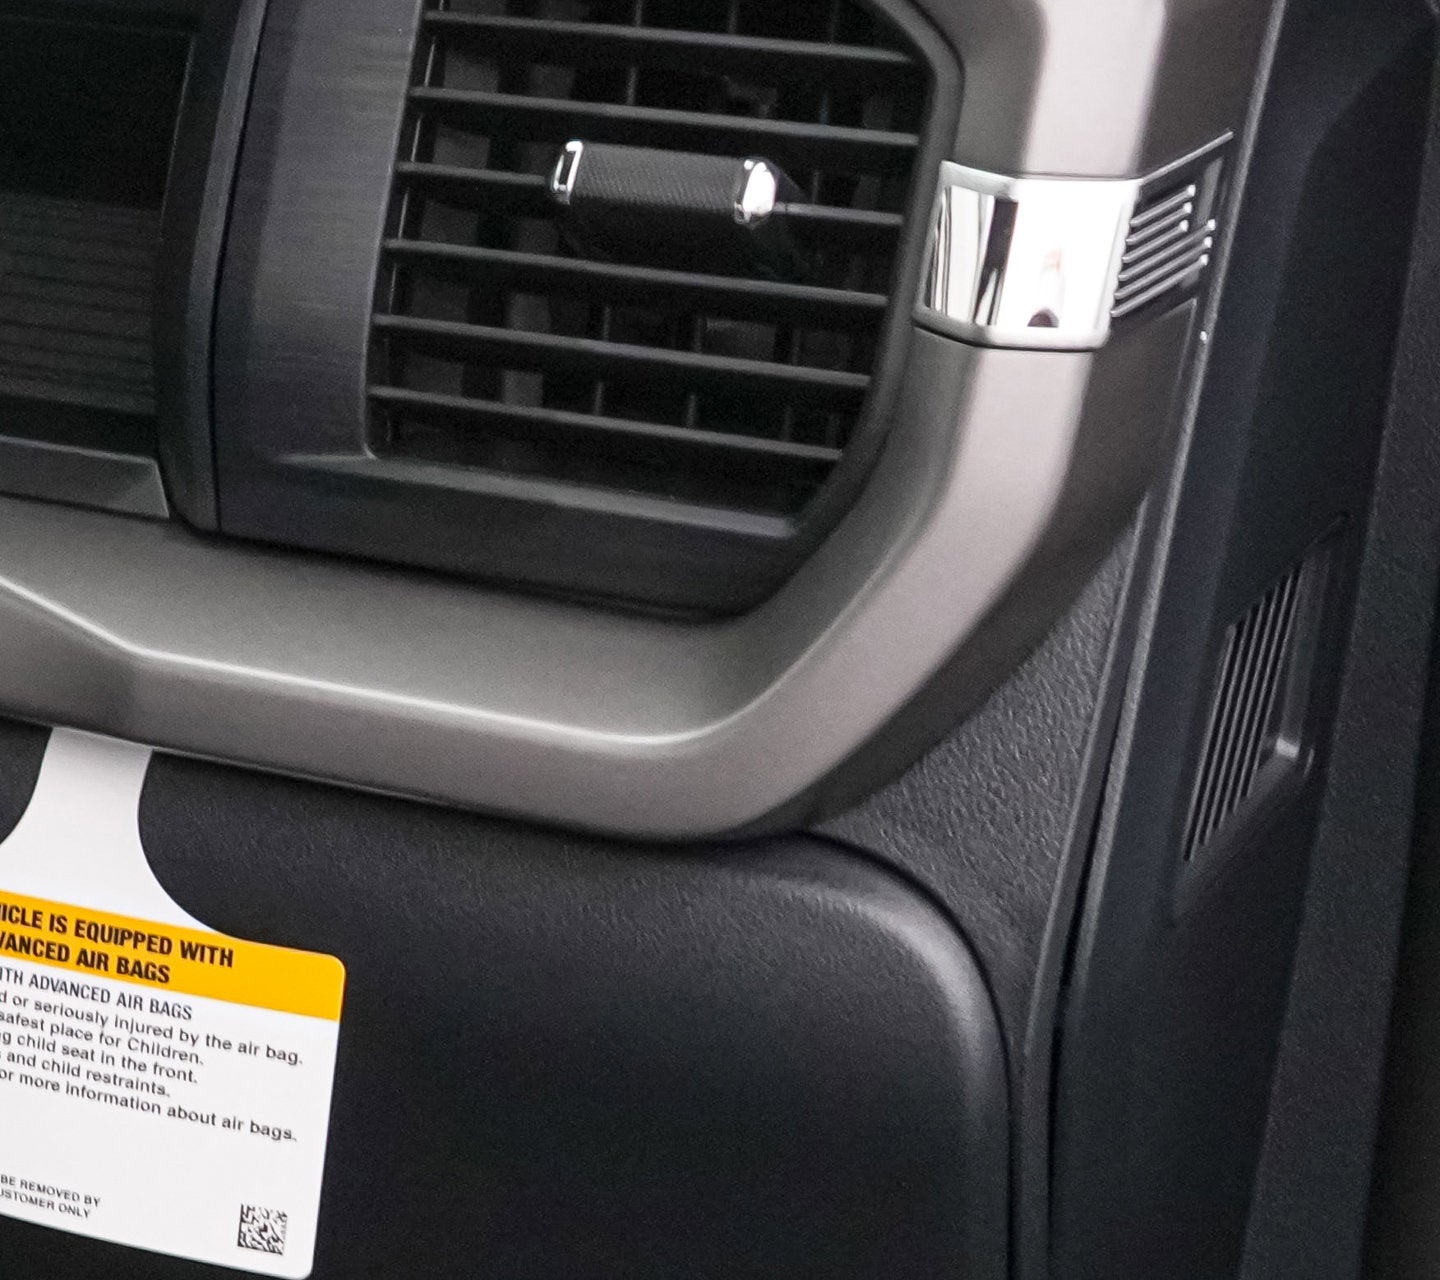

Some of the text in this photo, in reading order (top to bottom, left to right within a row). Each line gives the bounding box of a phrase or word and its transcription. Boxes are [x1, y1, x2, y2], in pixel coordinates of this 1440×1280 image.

[48, 913, 68, 934] IS
[74, 918, 173, 955] EQUIPPED
[179, 939, 233, 968] WITH
[75, 947, 109, 972] AIR
[115, 956, 170, 984] BAGS
[28, 973, 111, 1004] ADVANCED
[116, 991, 143, 1011] AIR
[149, 998, 192, 1020] BAGS
[12, 995, 29, 1008] or
[34, 1000, 109, 1028] seriously
[114, 1014, 173, 1039] injured
[179, 1027, 199, 1047] by
[205, 1033, 232, 1050] the
[237, 1041, 259, 1056] air
[265, 1044, 302, 1066] bag.
[49, 1022, 93, 1041] place
[99, 1030, 121, 1048] for
[127, 1036, 203, 1065] Children.
[6, 1052, 36, 1067] and
[41, 1058, 81, 1078] child
[86, 1069, 170, 1097] restraints.
[17, 1034, 56, 1053] child
[61, 1045, 95, 1062] seat
[100, 1050, 115, 1066] in
[121, 1055, 147, 1072] the
[153, 1061, 197, 1083] front.
[19, 1073, 60, 1092] more
[65, 1080, 161, 1115] information
[166, 1105, 216, 1126] about
[221, 1116, 243, 1131] air
[249, 1119, 296, 1141] bags.
[0, 1174, 15, 1186] BE
[19, 1179, 80, 1202] REMOVED
[83, 1195, 100, 1207] BY
[58, 1203, 90, 1218] ONLY
